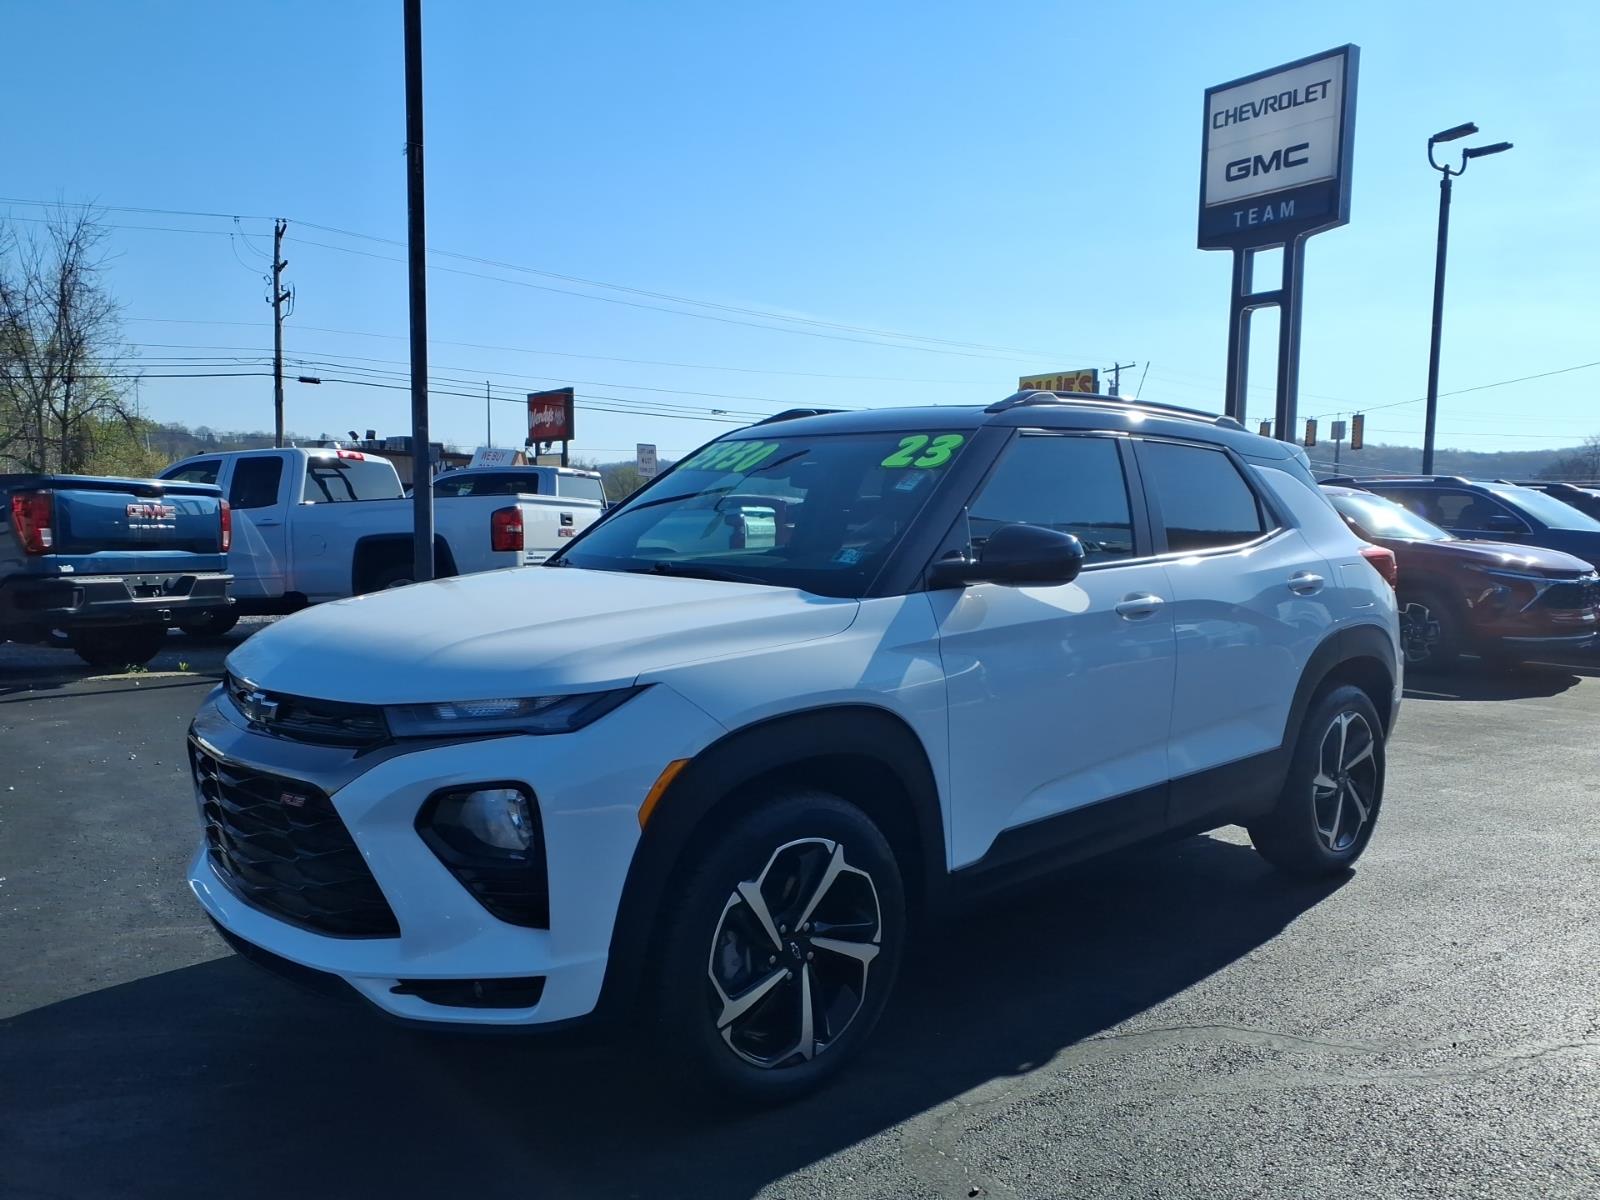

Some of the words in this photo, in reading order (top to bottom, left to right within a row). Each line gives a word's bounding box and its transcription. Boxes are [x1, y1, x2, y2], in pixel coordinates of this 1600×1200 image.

[1212, 79, 1332, 130] CHEVROLET
[1225, 142, 1310, 182] GMC
[1233, 200, 1295, 228] TEAM
[881, 434, 965, 469] 23
